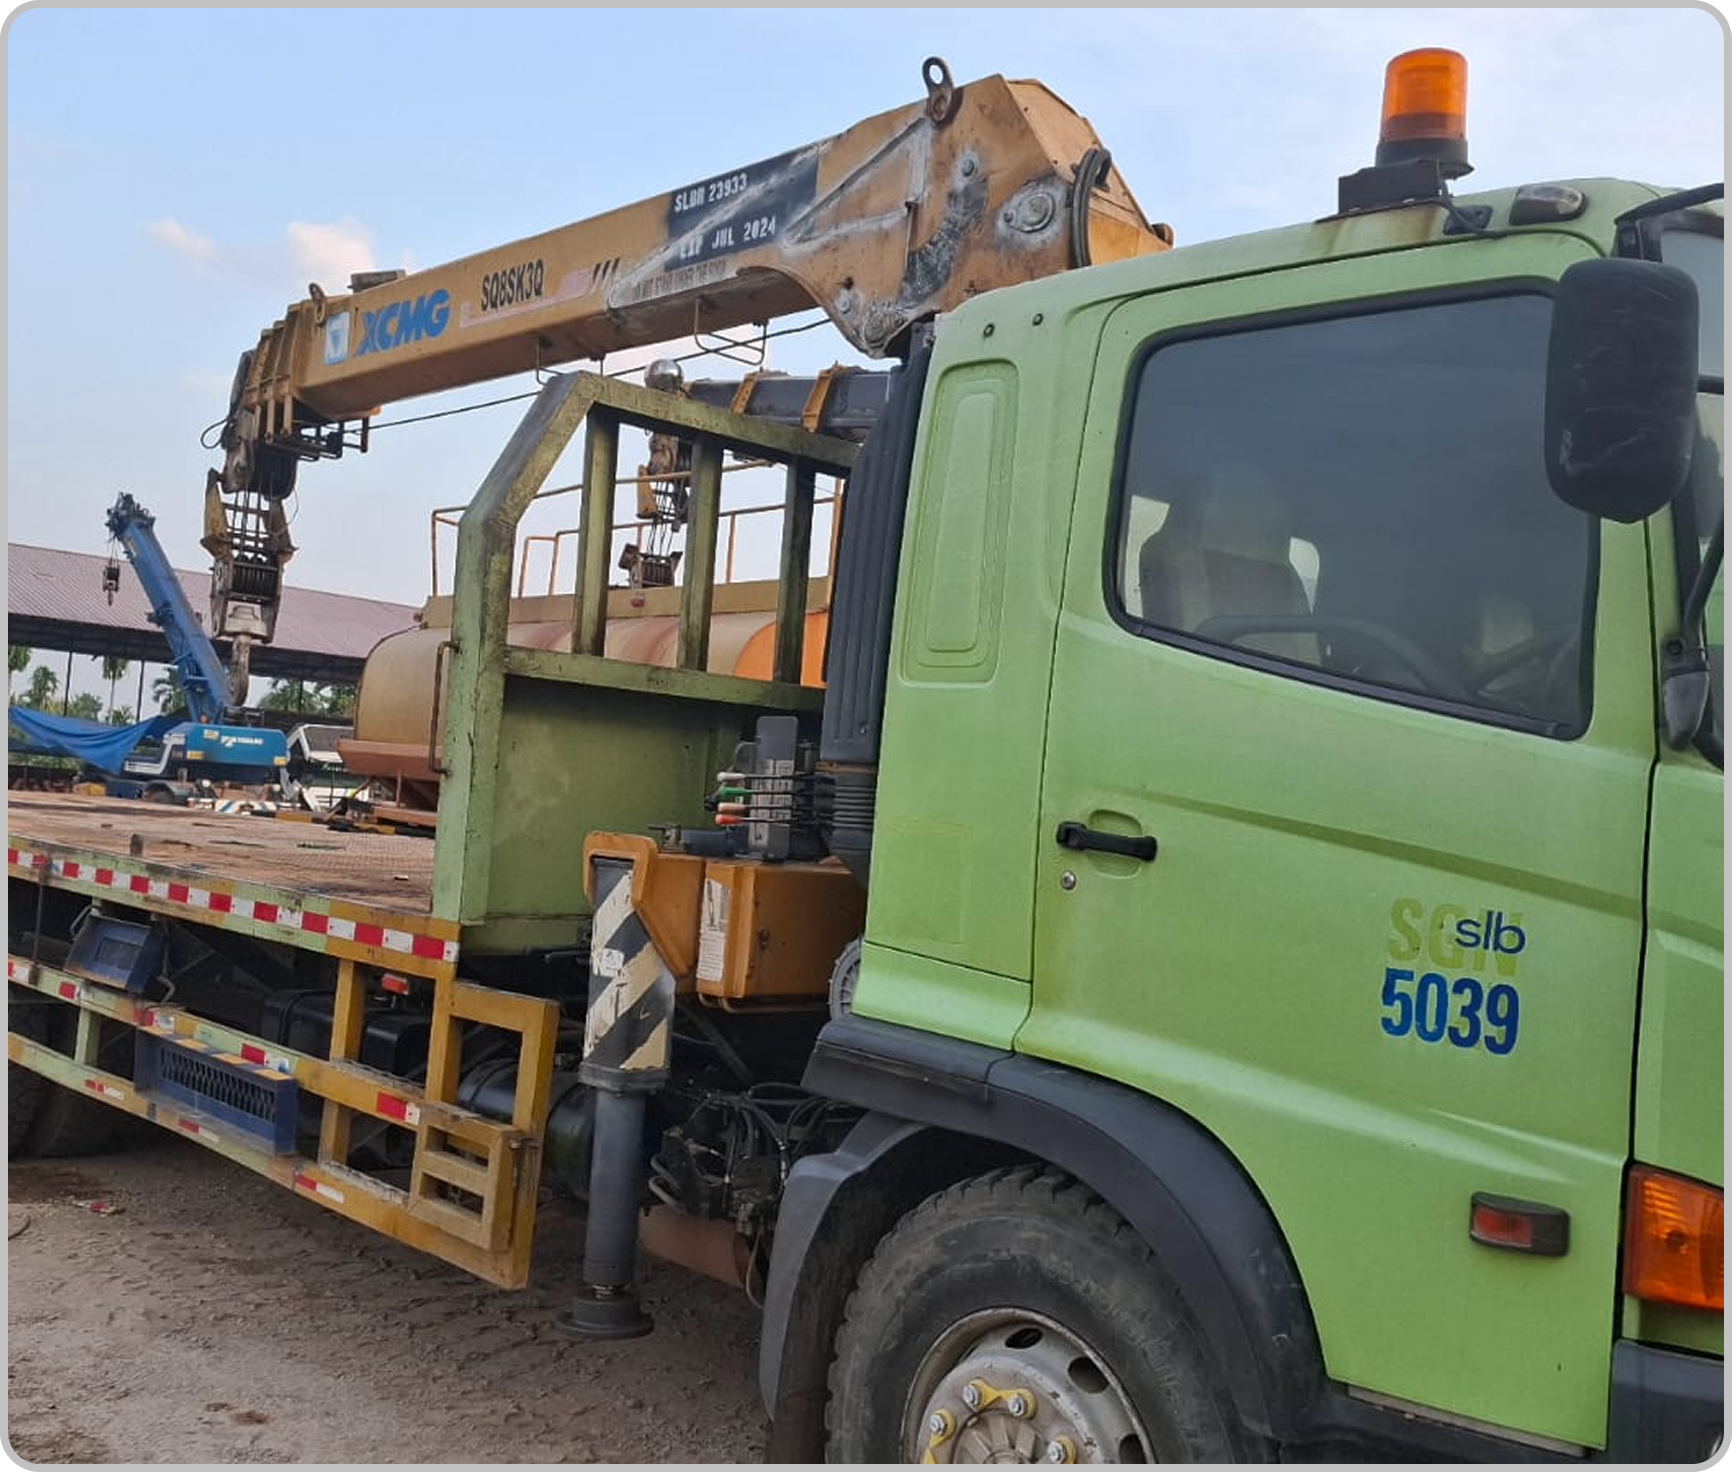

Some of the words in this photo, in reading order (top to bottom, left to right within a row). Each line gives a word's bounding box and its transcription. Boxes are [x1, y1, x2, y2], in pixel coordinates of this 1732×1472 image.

[708, 173, 748, 202] 23933
[743, 216, 776, 241] 2024
[481, 258, 543, 311] SQ8SK3Q
[356, 289, 450, 356] XCMG
[1454, 910, 1526, 954] slb
[1381, 967, 1520, 1056] 5039
